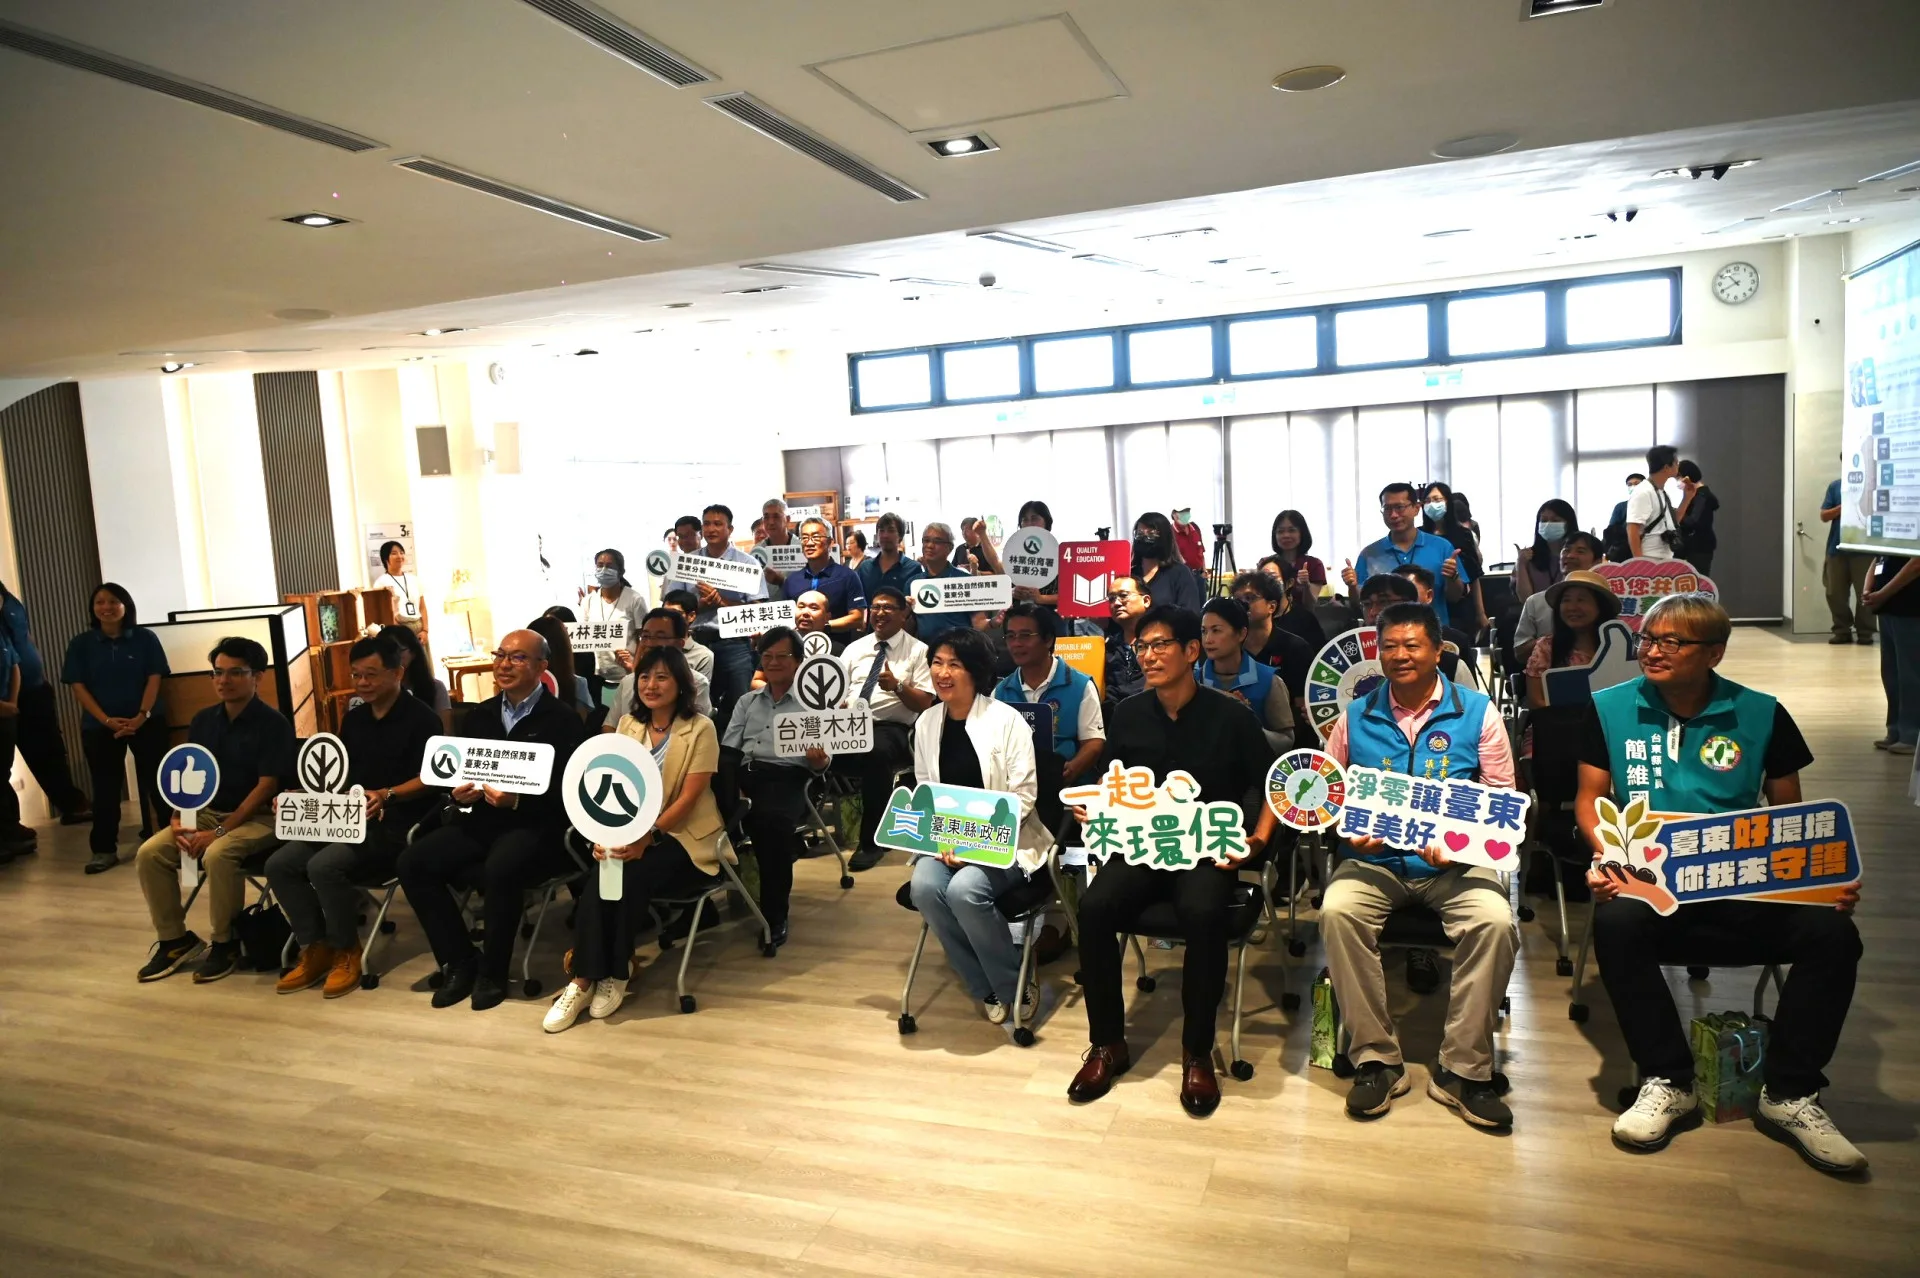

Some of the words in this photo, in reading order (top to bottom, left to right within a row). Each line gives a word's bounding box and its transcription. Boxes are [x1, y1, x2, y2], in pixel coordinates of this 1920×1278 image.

[1063, 547, 1072, 563] 4
[1076, 546, 1098, 554] QUALITY
[1076, 555, 1105, 563] EDUCATION
[1009, 555, 1054, 568] 林業保育署
[1012, 565, 1049, 577] 臺東分署
[721, 604, 793, 625] 山林製造
[735, 625, 761, 634] FOREST
[777, 711, 869, 741] 台灣木材
[467, 747, 536, 760] 林業及自然保育署
[830, 739, 868, 751] WOOD
[464, 759, 499, 770] 臺東分署
[1064, 765, 1157, 810] 一起
[1347, 769, 1526, 831] 淨零讓臺東
[280, 797, 363, 825] 台灣木材
[280, 825, 321, 837] TAIWAN
[326, 827, 360, 839] WOOD
[931, 815, 1011, 844] 臺東縣政府
[1086, 806, 1245, 867] 來環保
[1341, 805, 1437, 850] 更美好
[1671, 810, 1836, 858] 臺東好環境
[930, 833, 951, 844] Taitung
[951, 838, 972, 848] County
[973, 842, 1009, 853] Government
[1675, 841, 1848, 893] 你我來守護
